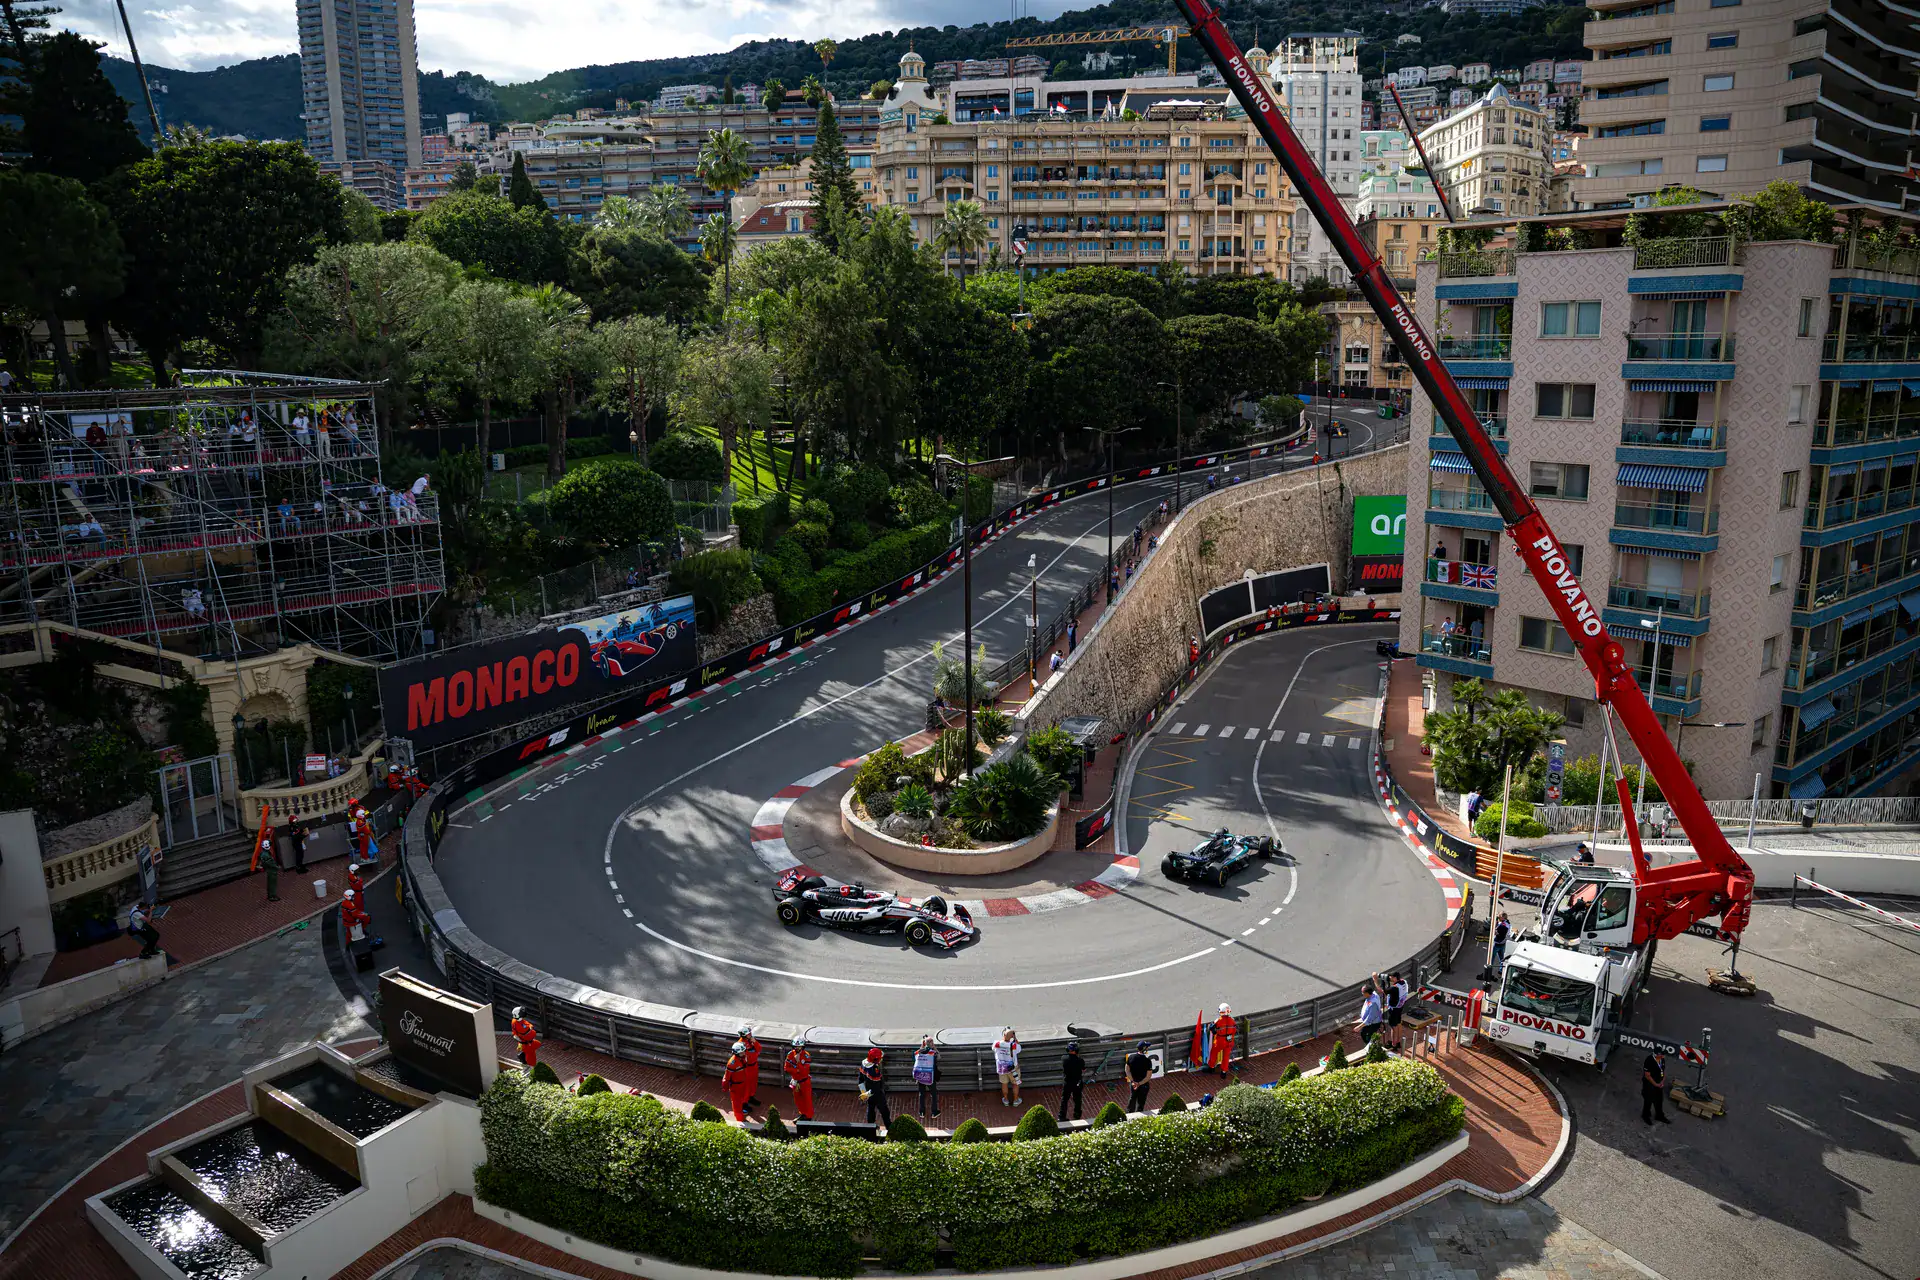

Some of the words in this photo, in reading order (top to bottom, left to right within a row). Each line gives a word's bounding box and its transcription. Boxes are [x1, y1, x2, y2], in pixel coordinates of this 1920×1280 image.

[1229, 56, 1270, 112] PIOVANO
[1391, 304, 1431, 361] PIOVANO
[1532, 535, 1601, 637] PIOVANO
[407, 643, 580, 732] MONACO
[701, 666, 727, 685] Monaco
[586, 714, 617, 735] Monaco
[525, 762, 604, 801] TAXIS
[1434, 832, 1460, 861] Monaco
[825, 911, 869, 921] HAAS
[399, 1010, 456, 1053] Fairmont
[1503, 1009, 1586, 1040] PIOVANO
